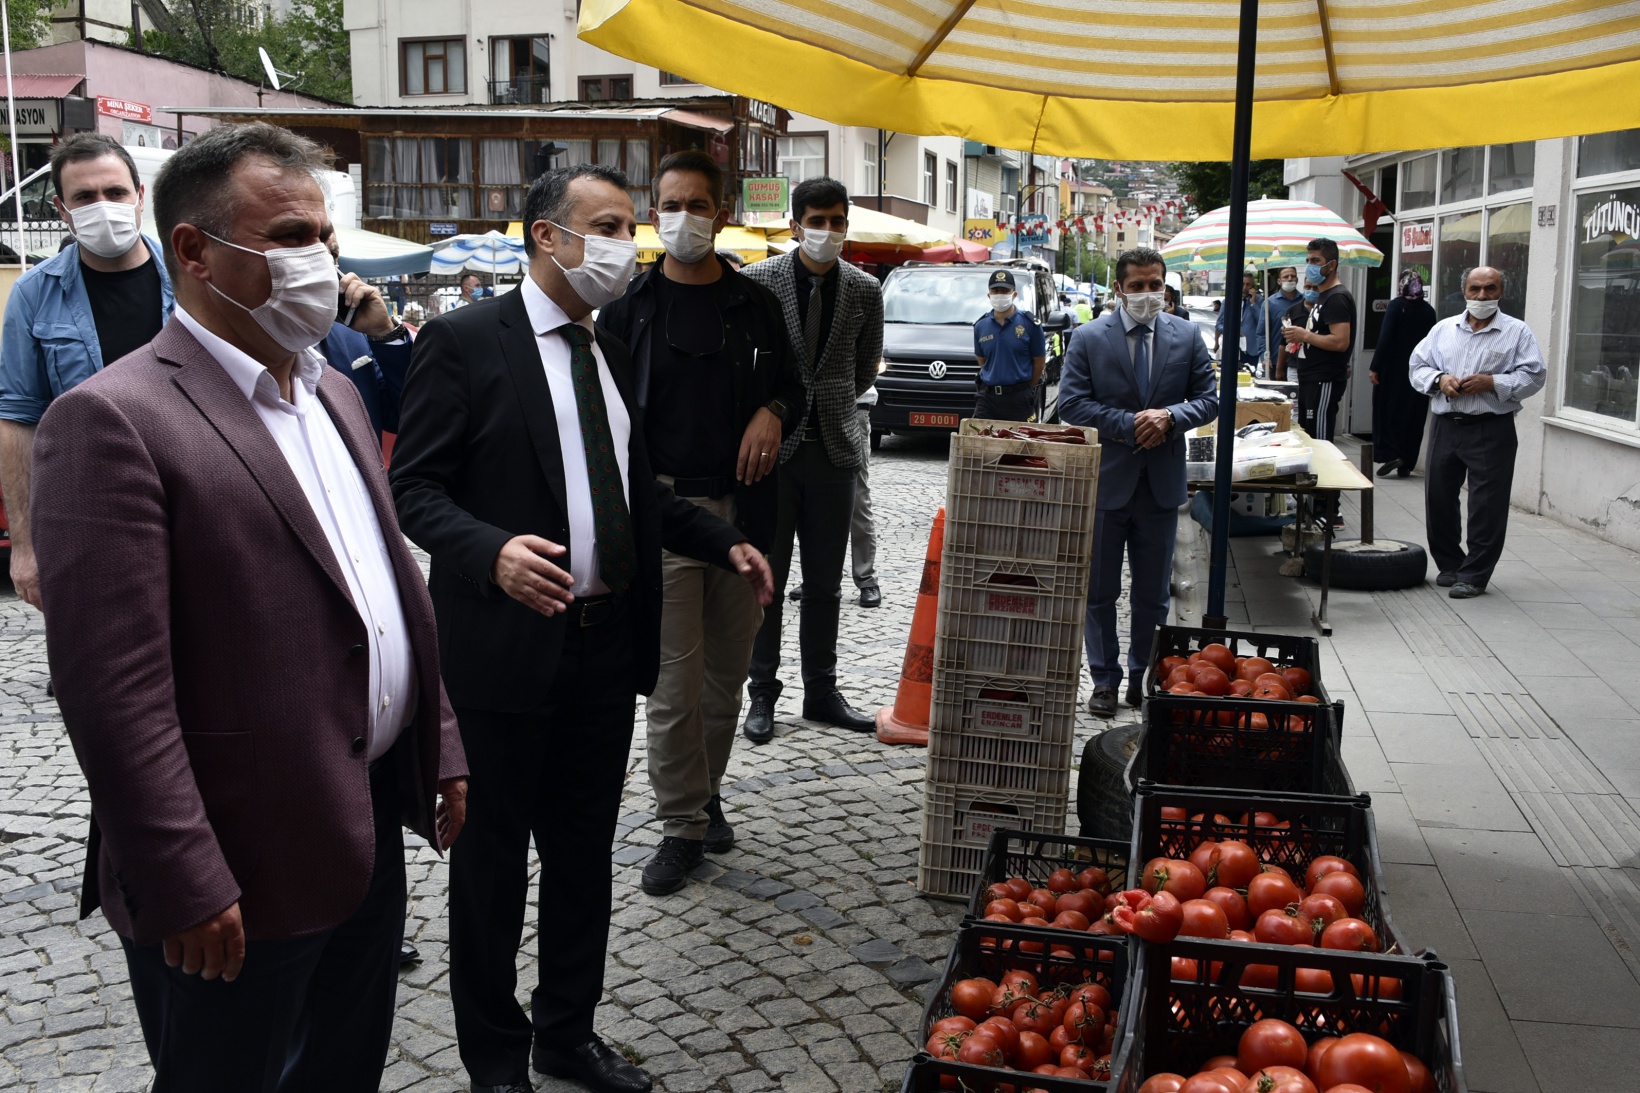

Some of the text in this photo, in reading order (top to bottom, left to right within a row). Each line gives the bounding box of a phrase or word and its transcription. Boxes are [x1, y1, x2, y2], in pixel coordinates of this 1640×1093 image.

[0, 105, 45, 125] NİASYON
[748, 181, 781, 193] GÜMÜŞ
[749, 193, 780, 202] KASAP
[1585, 194, 1640, 244] TÜTÜNCÜ
[968, 227, 992, 241] ŞOK
[1403, 227, 1412, 247] 15
[914, 415, 954, 425] 29 0001
[981, 710, 1023, 722] ERDEMLER
